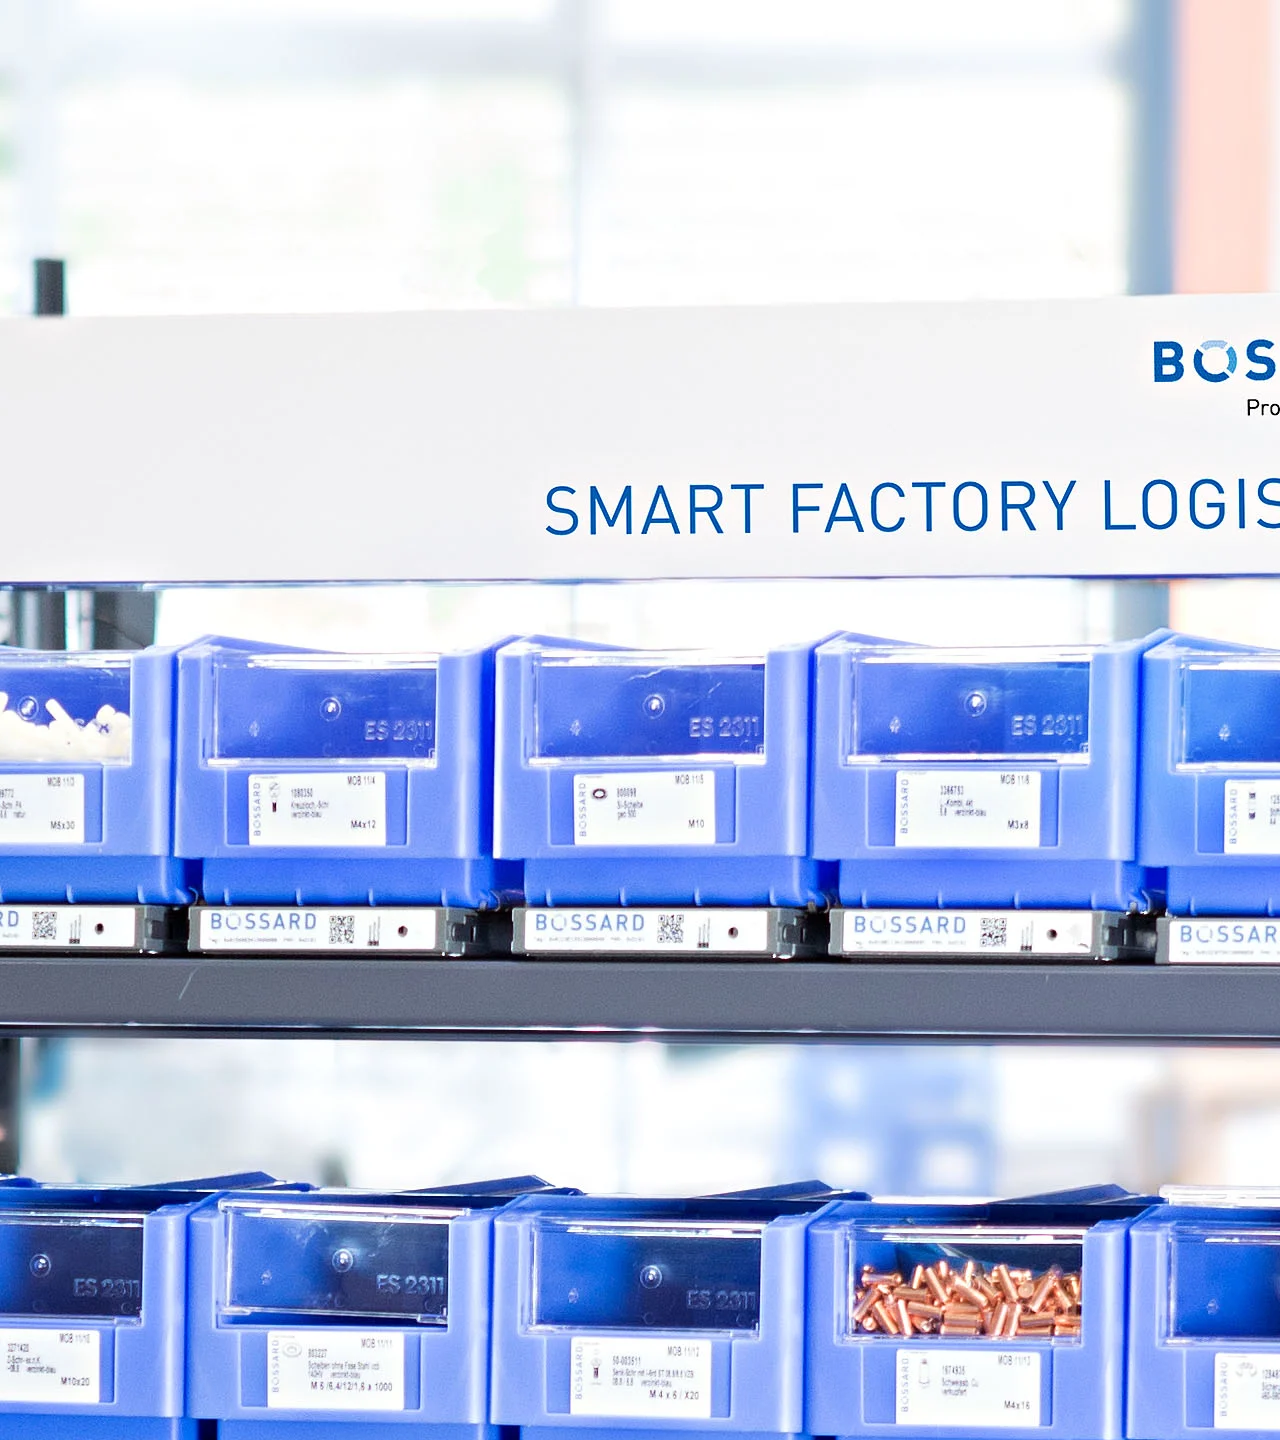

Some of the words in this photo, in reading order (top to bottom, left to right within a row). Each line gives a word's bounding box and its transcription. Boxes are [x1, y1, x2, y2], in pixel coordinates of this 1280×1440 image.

[546, 484, 764, 535] SMART
[792, 481, 1076, 532] FACTORY
[351, 820, 375, 828] M4x12
[689, 819, 704, 828] M10
[1008, 820, 1028, 829] M3x8
[211, 913, 316, 930] BOSSARD
[536, 914, 644, 931] BOSSARD
[854, 916, 965, 934] BOSSARD
[61, 1377, 89, 1386] M10x20
[375, 1382, 392, 1391] 1000
